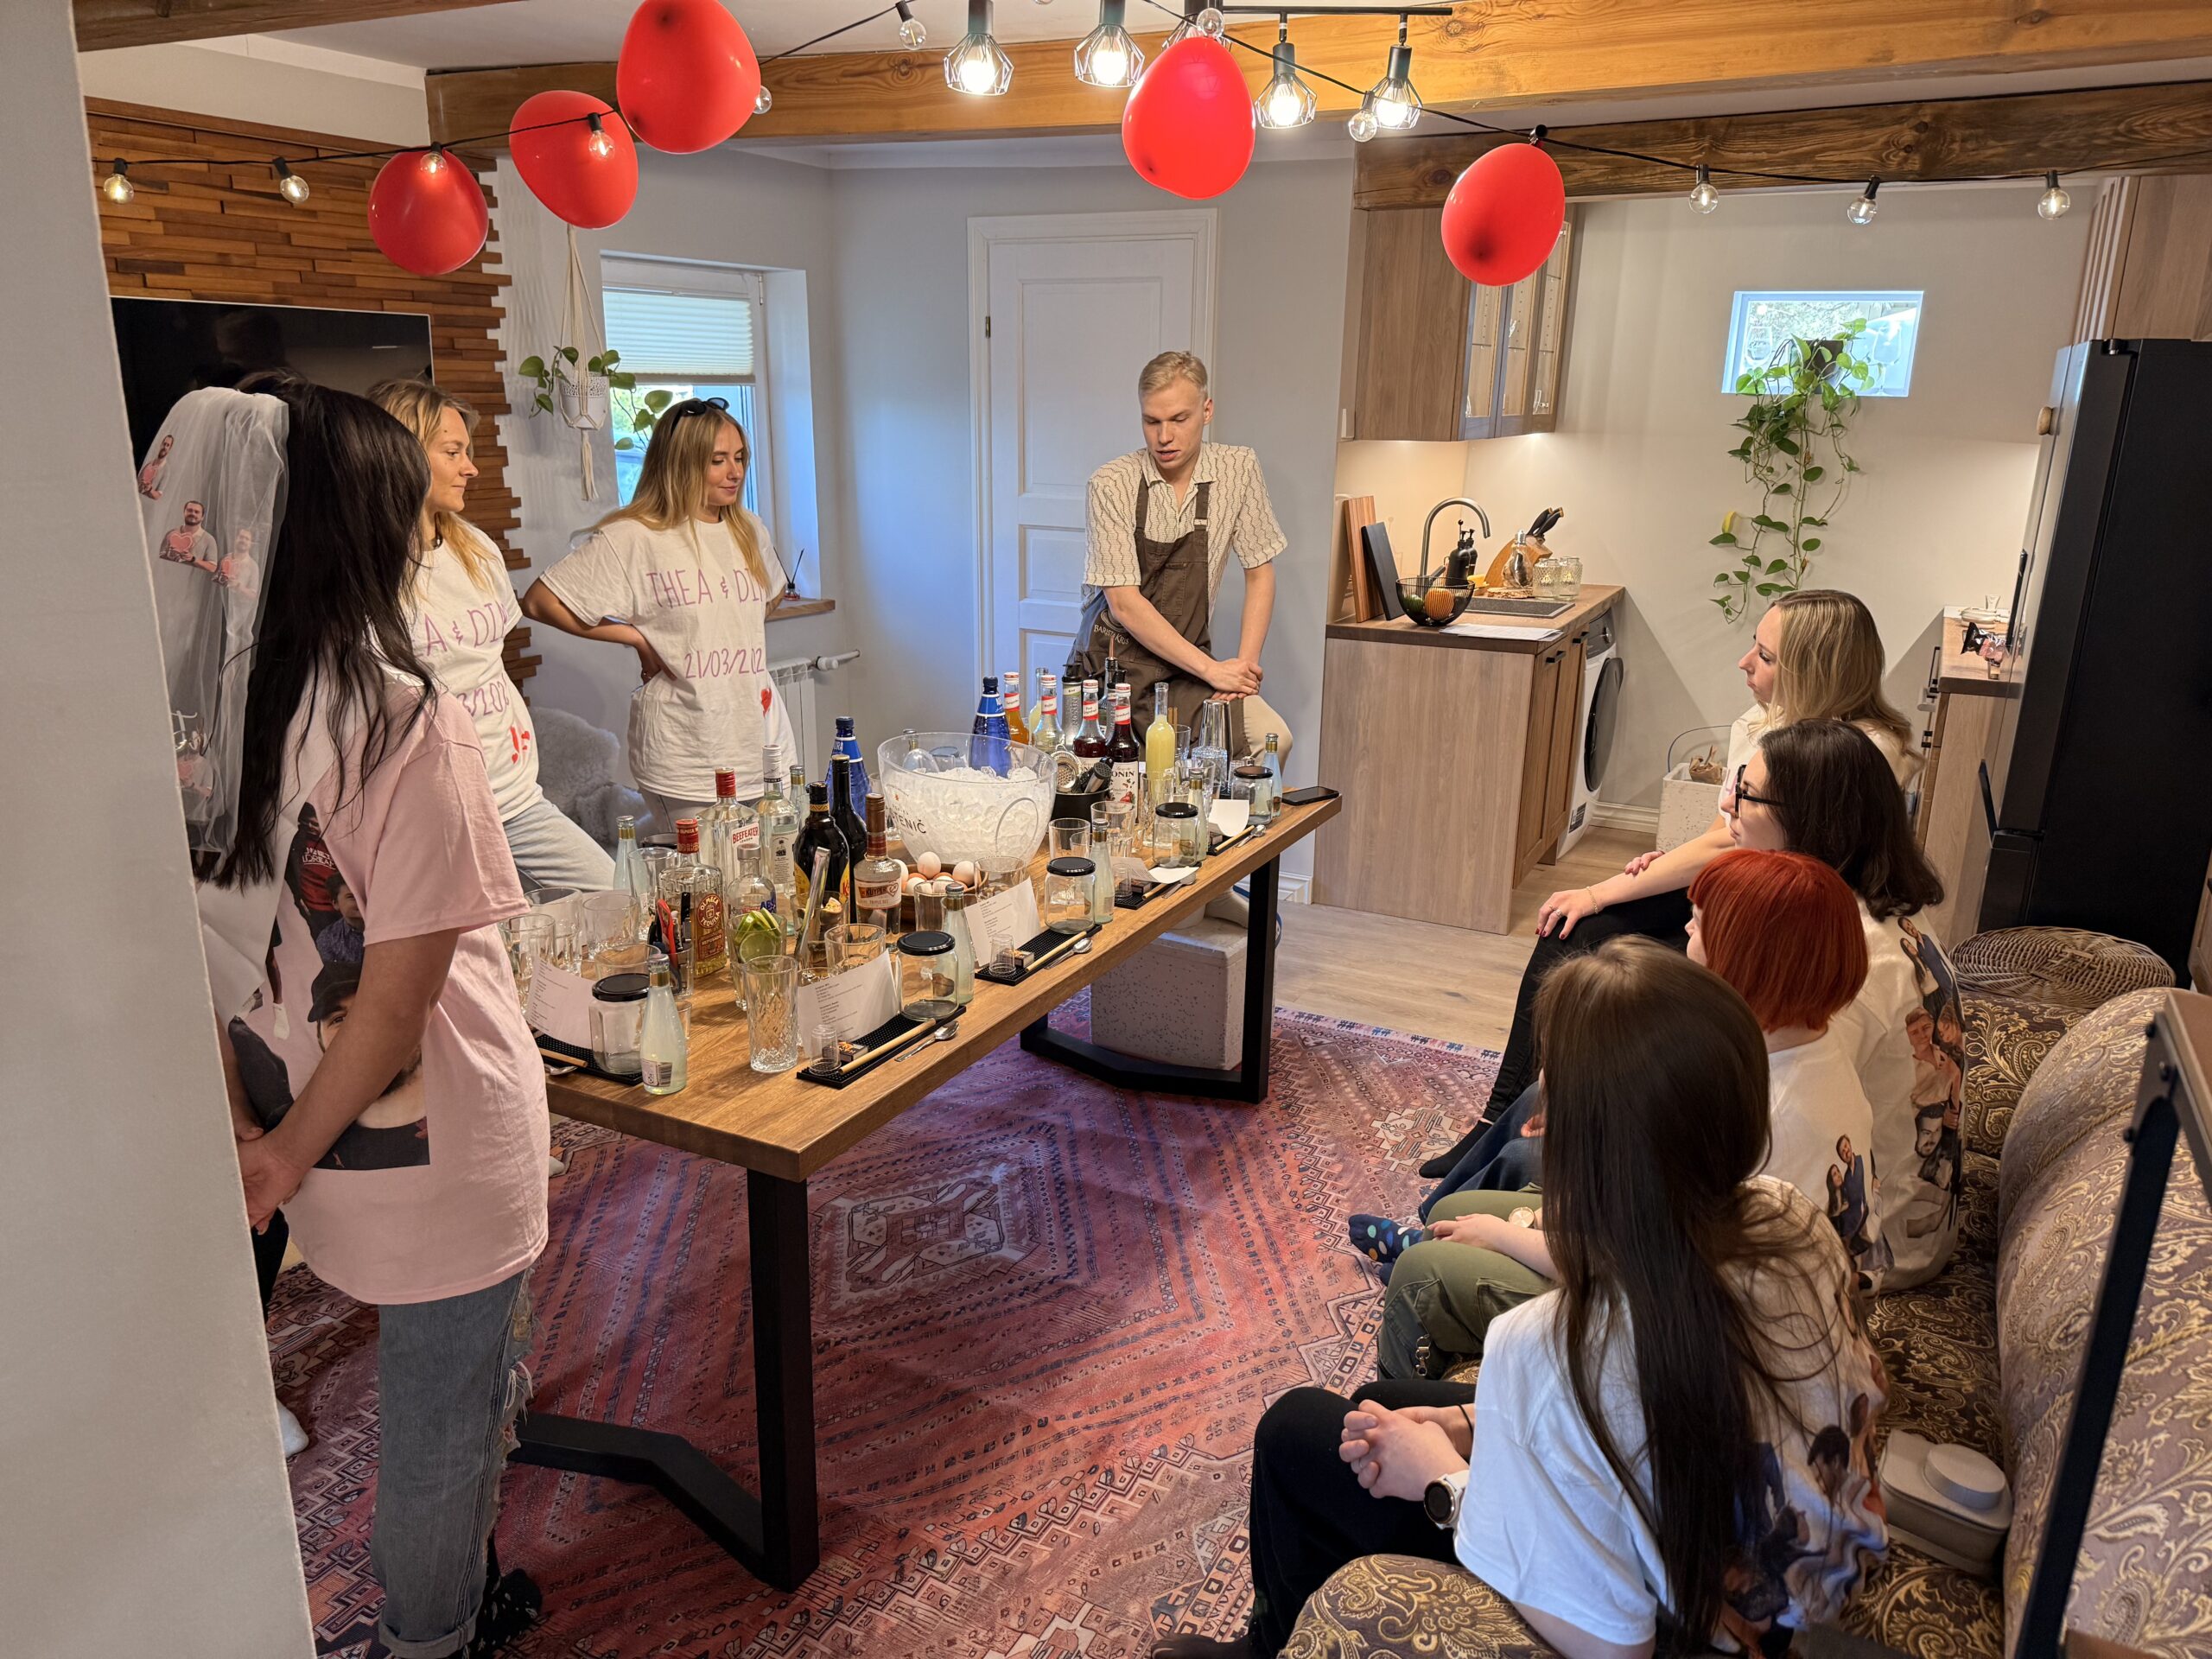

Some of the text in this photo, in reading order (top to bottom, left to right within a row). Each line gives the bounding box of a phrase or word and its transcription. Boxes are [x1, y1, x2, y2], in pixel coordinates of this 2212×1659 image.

[646, 569, 714, 608] THEA
[732, 826, 759, 844] BEEFEATER
[700, 896, 719, 911] OLMECA
[700, 911, 721, 927] TEQUILA
